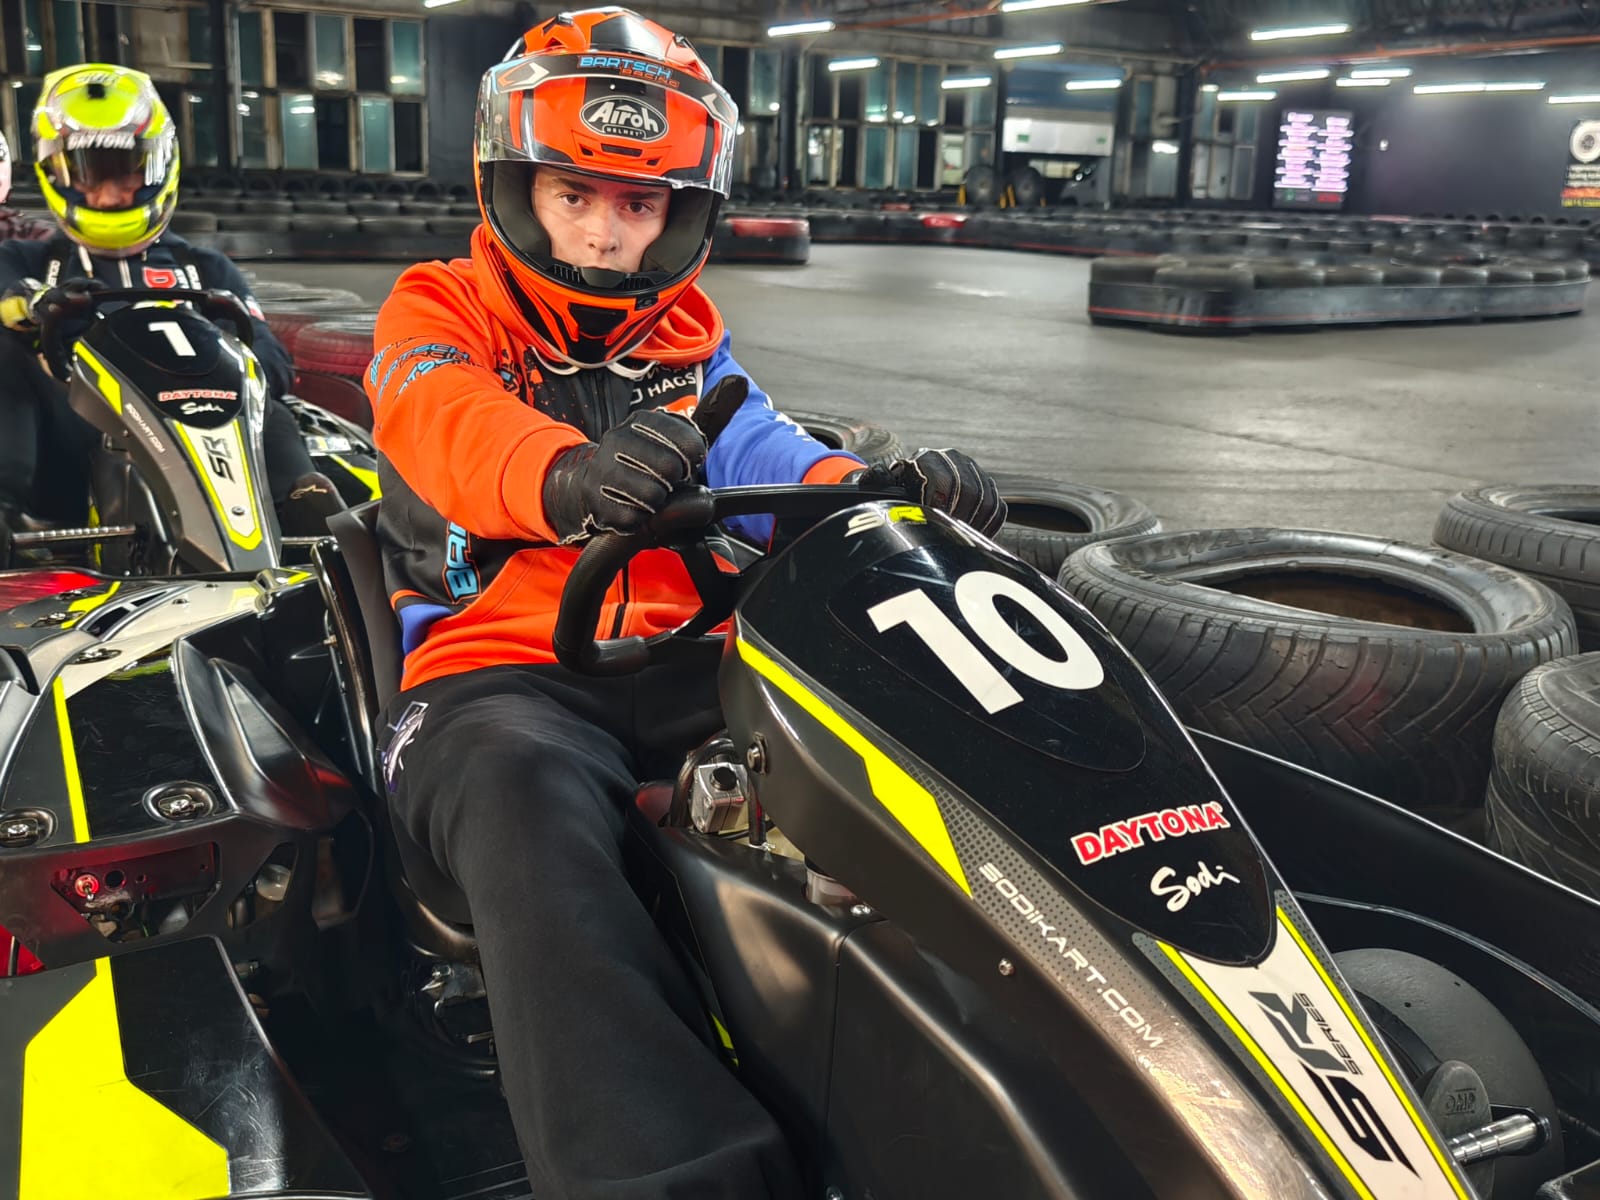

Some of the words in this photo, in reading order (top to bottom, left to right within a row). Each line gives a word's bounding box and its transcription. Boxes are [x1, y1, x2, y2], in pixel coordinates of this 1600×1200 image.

[579, 56, 672, 79] BARTSCH
[621, 69, 680, 88] RACING
[589, 101, 659, 132] Airoh
[148, 321, 197, 356] 1
[158, 389, 238, 402] DAYTONA
[866, 570, 1105, 715] 10
[1150, 861, 1240, 912] Sodi
[1296, 992, 1364, 1076] SERIES
